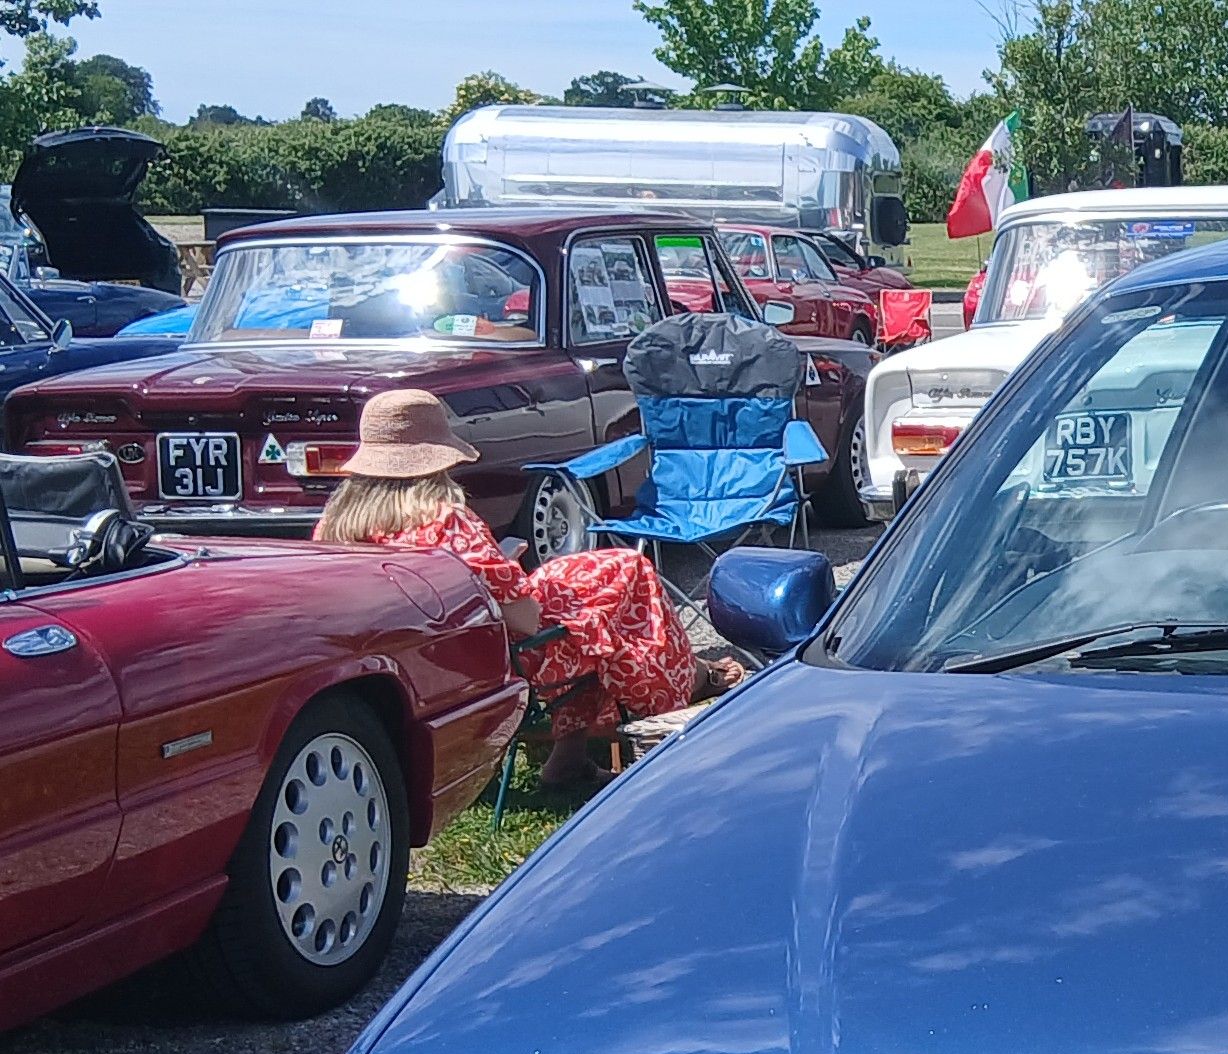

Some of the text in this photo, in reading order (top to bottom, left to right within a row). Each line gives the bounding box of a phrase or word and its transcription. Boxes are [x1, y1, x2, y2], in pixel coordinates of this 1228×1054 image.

[1056, 417, 1116, 447] RBY
[168, 438, 228, 467] FYR
[1046, 446, 1129, 476] 757K
[175, 468, 224, 495] 31J
